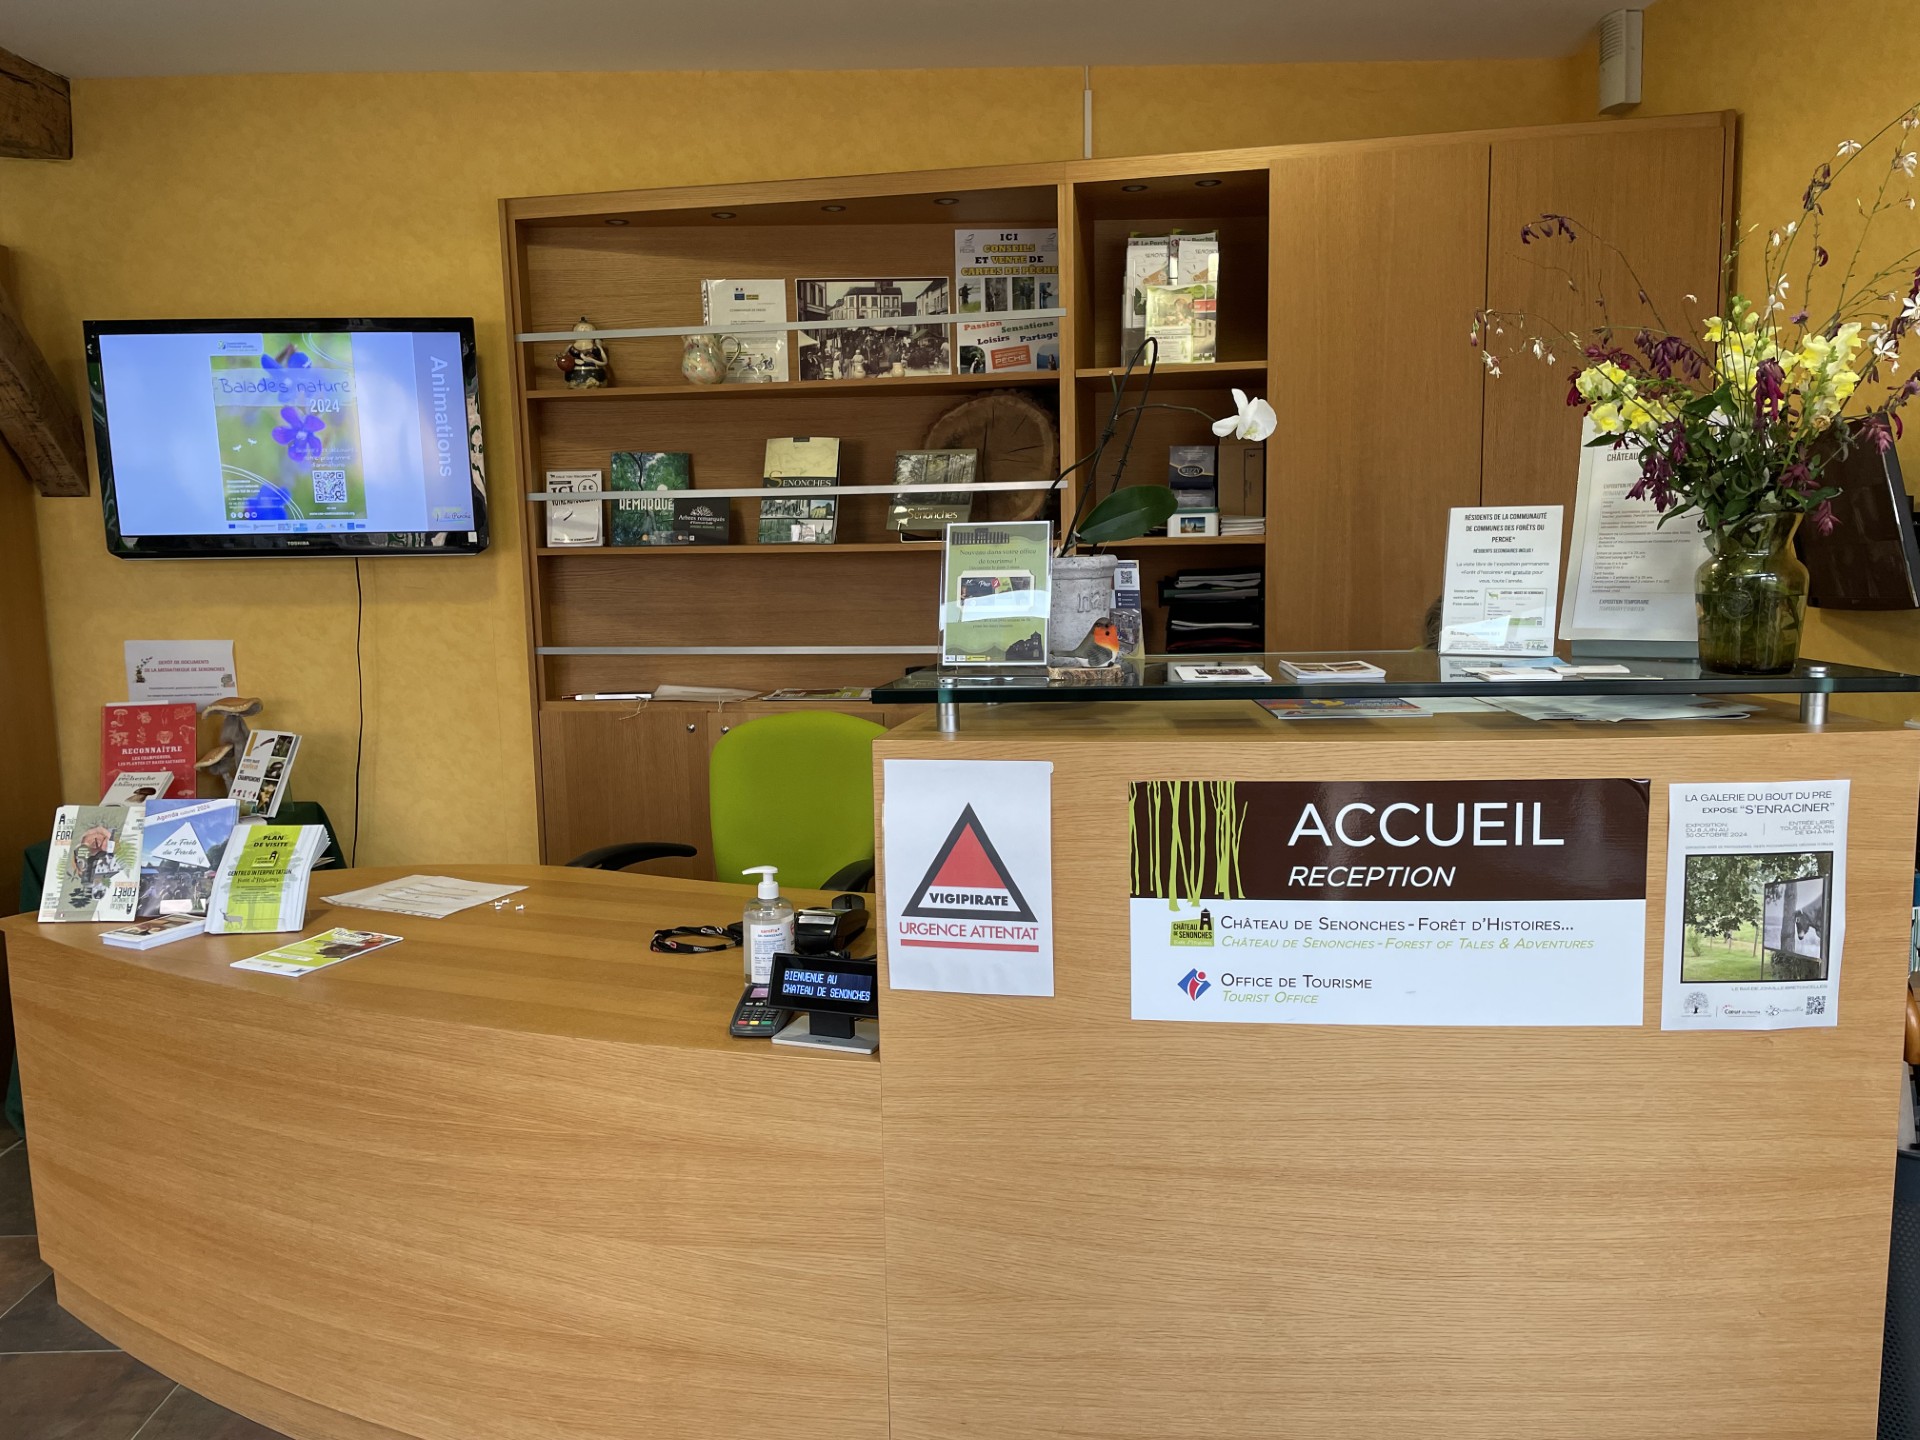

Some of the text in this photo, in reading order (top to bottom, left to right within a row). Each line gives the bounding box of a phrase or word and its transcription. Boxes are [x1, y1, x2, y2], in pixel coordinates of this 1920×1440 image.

[1000, 233, 1018, 241] ICI
[983, 244, 1035, 253] CONSEILS
[975, 256, 989, 264] ET
[991, 255, 1027, 264] VENTE
[961, 267, 1003, 276] CARTES
[1004, 266, 1019, 275] DE
[964, 321, 1002, 331] Passion
[1001, 321, 1054, 333] Sensations
[977, 335, 1010, 345] Loisirs
[219, 378, 351, 394] Balades nature
[310, 399, 340, 413] 2024
[430, 355, 454, 477] Animations
[1606, 452, 1639, 462] CHÂTEAU
[767, 470, 833, 488] SENONCHES
[907, 508, 959, 521] Senonches
[1465, 512, 1548, 523] RÉSIDENTS DE LA COMMUNAUTÉ
[1505, 524, 1515, 532] DES
[1516, 523, 1536, 531] FORÊTS
[122, 745, 183, 755] RECONNAÎTRE
[1685, 791, 1832, 802] LA GALERIE DU BOUT DU PRE
[156, 812, 179, 822] Agenda
[196, 804, 211, 813] 2024
[1287, 801, 1565, 847] ACCUEIL
[165, 838, 198, 846] Les Forêts
[173, 848, 198, 856] Perche
[1287, 865, 1456, 888] RECEPTION
[929, 892, 1009, 906] VIGIPIRATE
[899, 921, 1040, 940] URGENCE ATTENTAT
[1173, 922, 1198, 931] CHÂTEAU
[1179, 931, 1213, 939] SENONCHES
[1499, 938, 1510, 949] &
[783, 970, 838, 986] BIENVENUE AU
[782, 983, 871, 1001] CHATEAU DE SENONCHES
